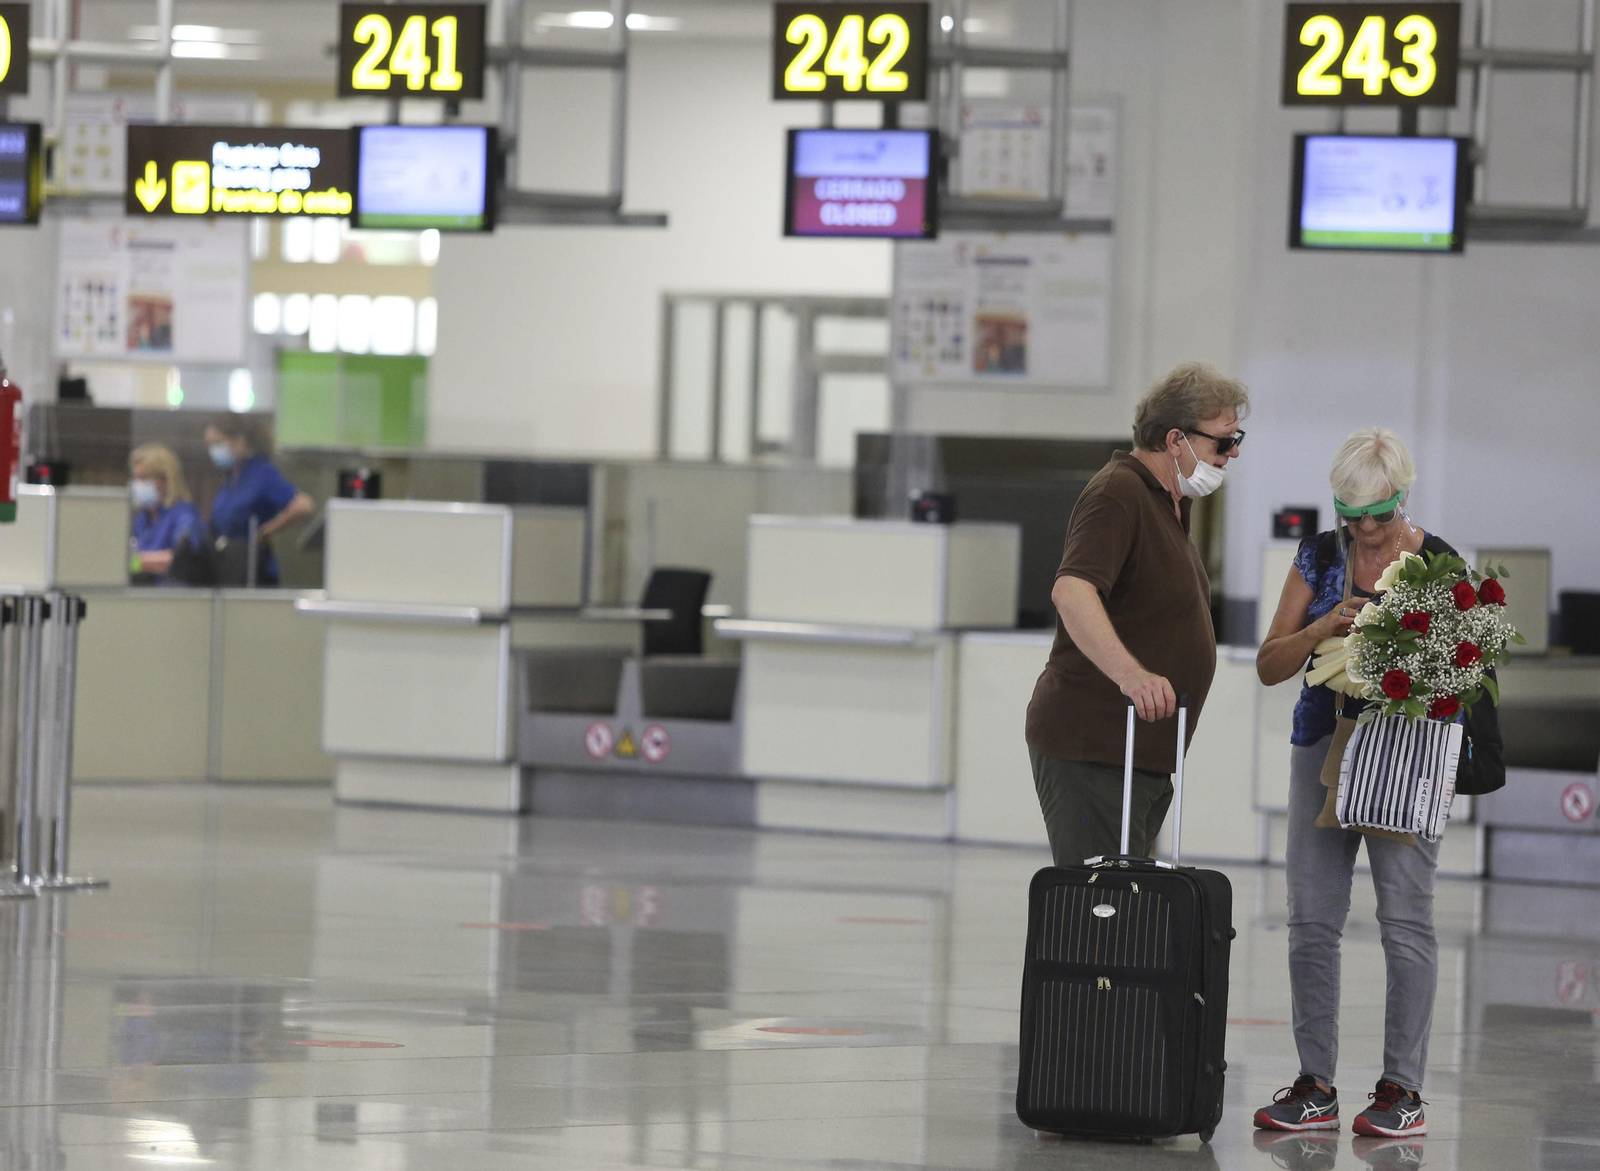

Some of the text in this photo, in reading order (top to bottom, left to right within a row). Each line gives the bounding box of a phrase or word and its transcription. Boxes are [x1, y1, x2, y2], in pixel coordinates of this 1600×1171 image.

[352, 14, 463, 91] 241
[784, 14, 910, 92] 242
[1297, 15, 1437, 96] 243
[819, 202, 897, 227] CLOSED
